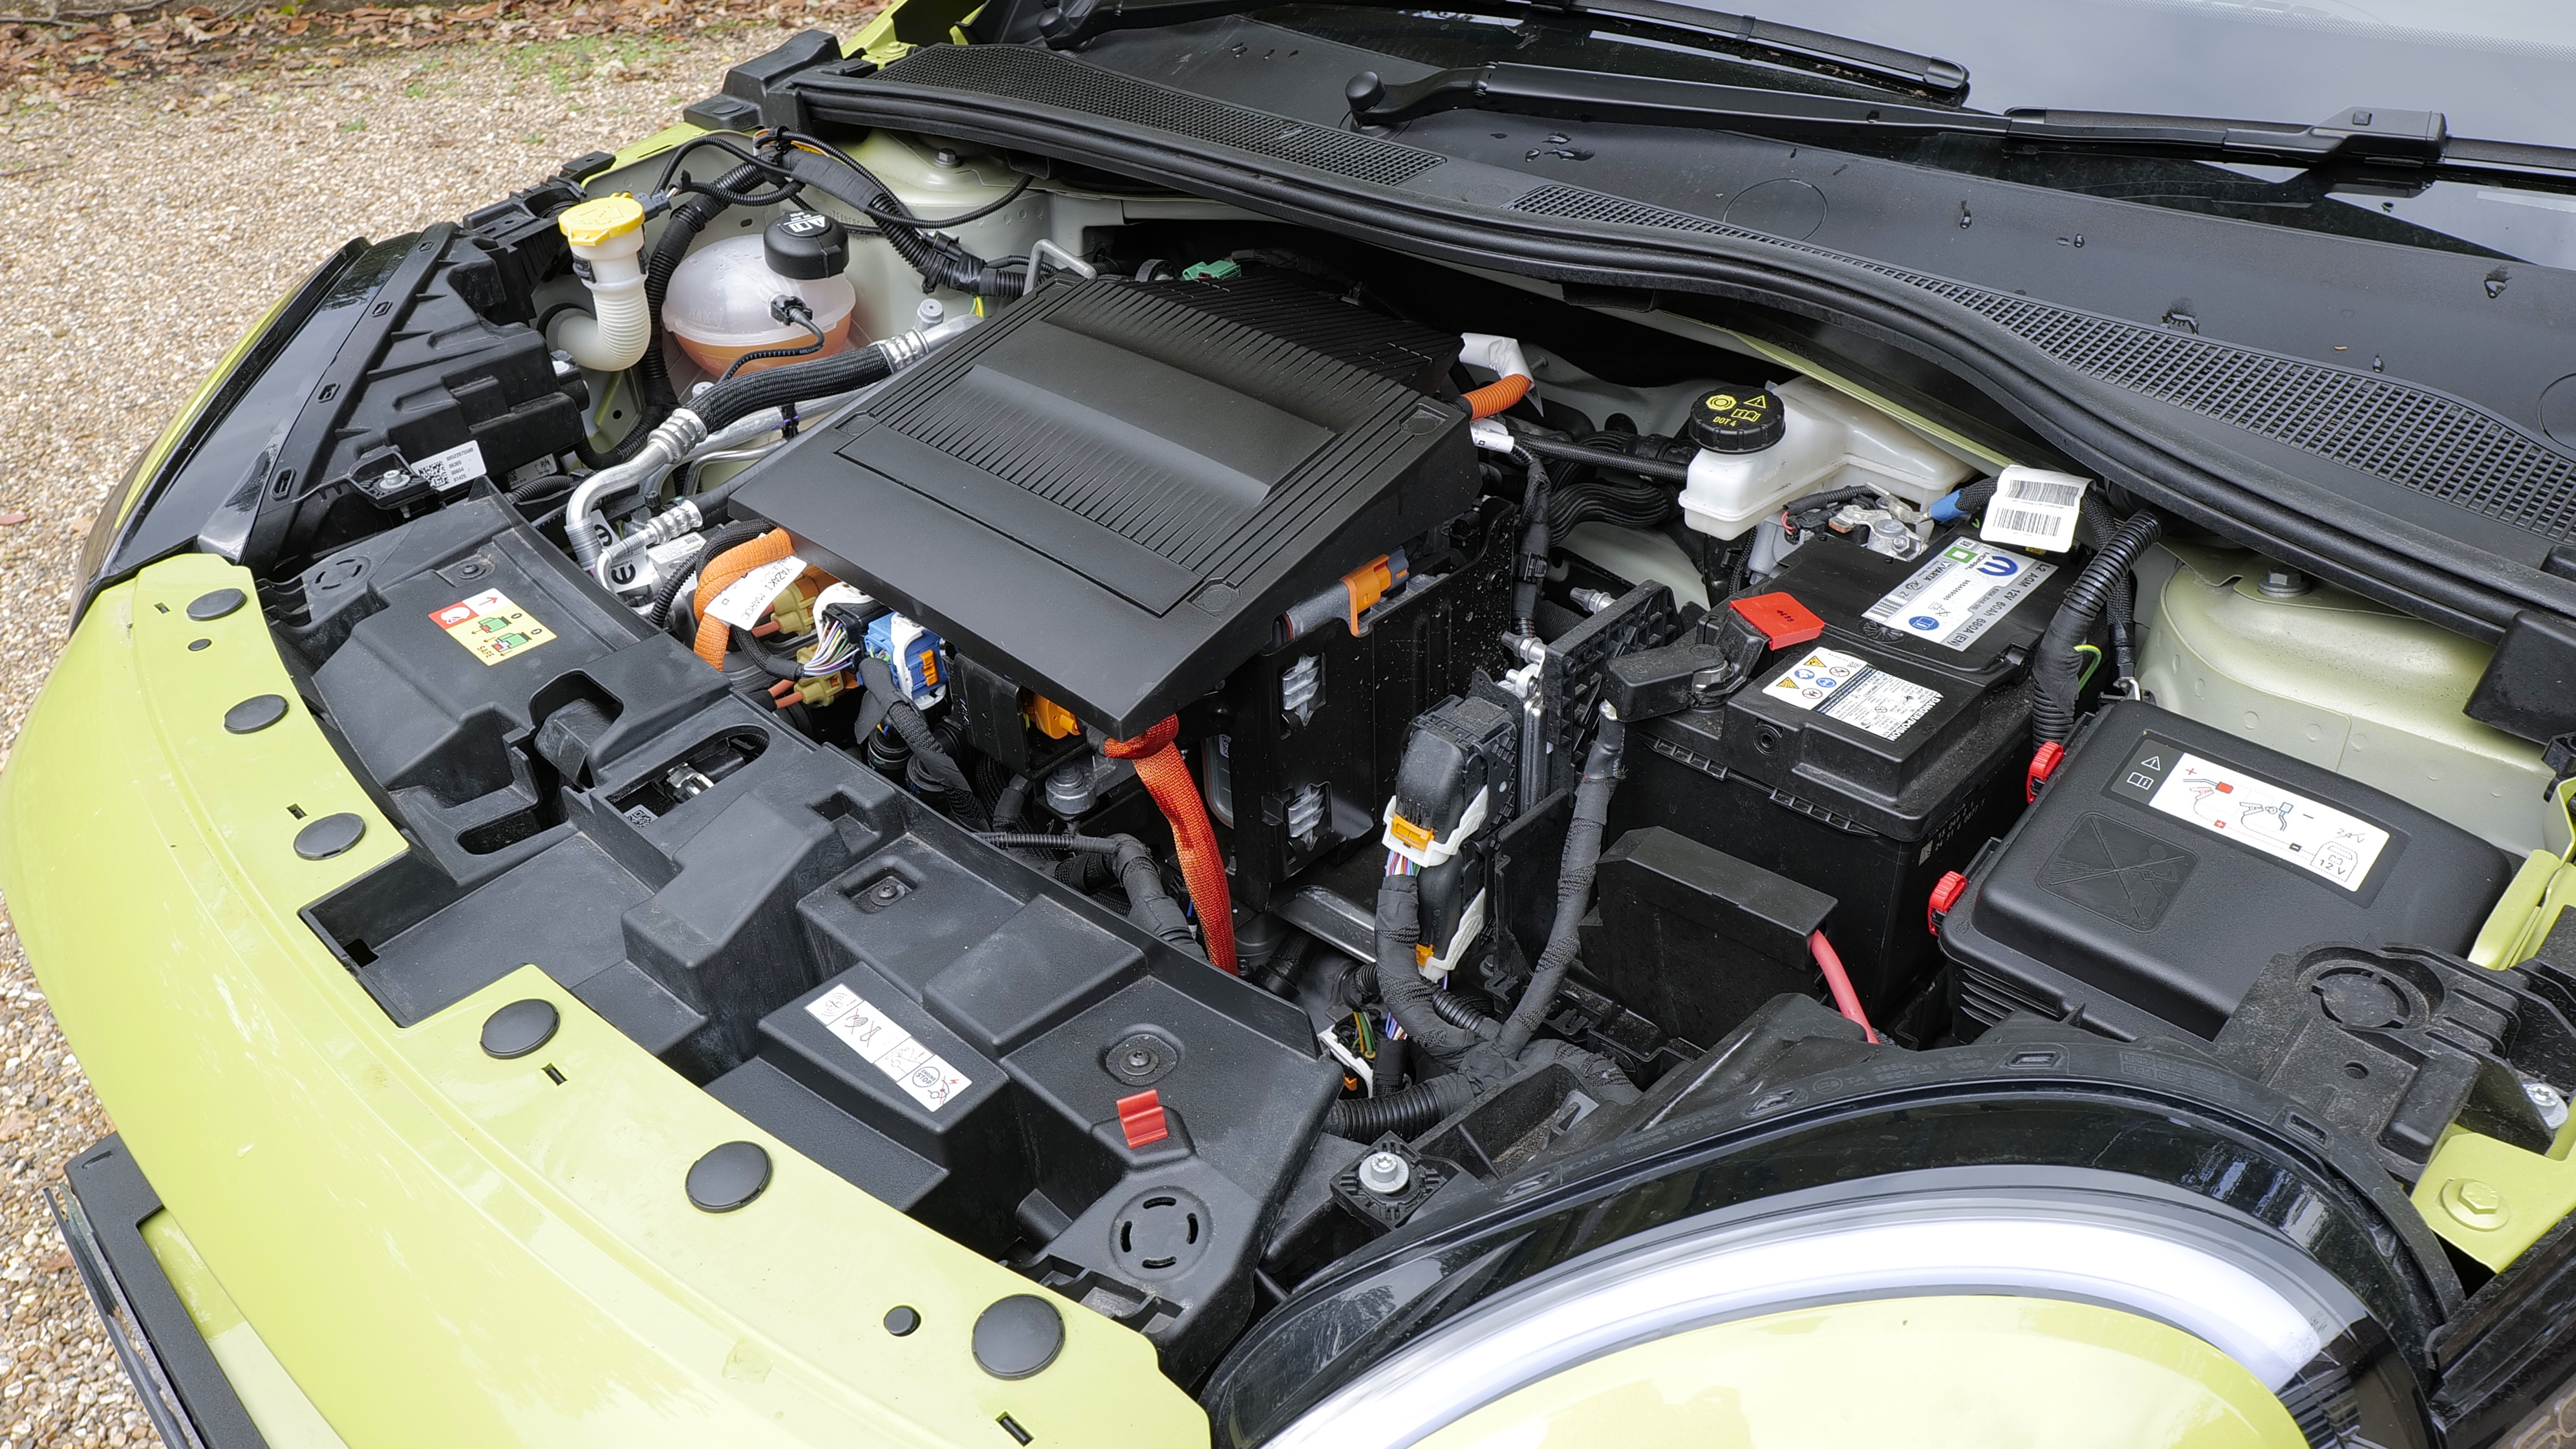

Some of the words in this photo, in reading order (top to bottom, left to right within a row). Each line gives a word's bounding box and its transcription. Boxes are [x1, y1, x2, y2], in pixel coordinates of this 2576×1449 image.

[1713, 416, 1730, 425] DOT
[1921, 565, 1946, 582] VARTA
[2034, 563, 2050, 572] L2
[764, 562, 793, 594] YAZAKI
[2017, 572, 2040, 587] AGM
[2002, 588, 2022, 601] 12V
[740, 592, 766, 621] MAROC
[1982, 601, 2007, 617] 60Ah
[1962, 617, 1988, 634] 680A
[1946, 632, 1970, 647] (EN)
[477, 646, 495, 658] SAFE
[1886, 696, 1940, 741] DANGER/POISON
[916, 1072, 932, 1084] STOP
